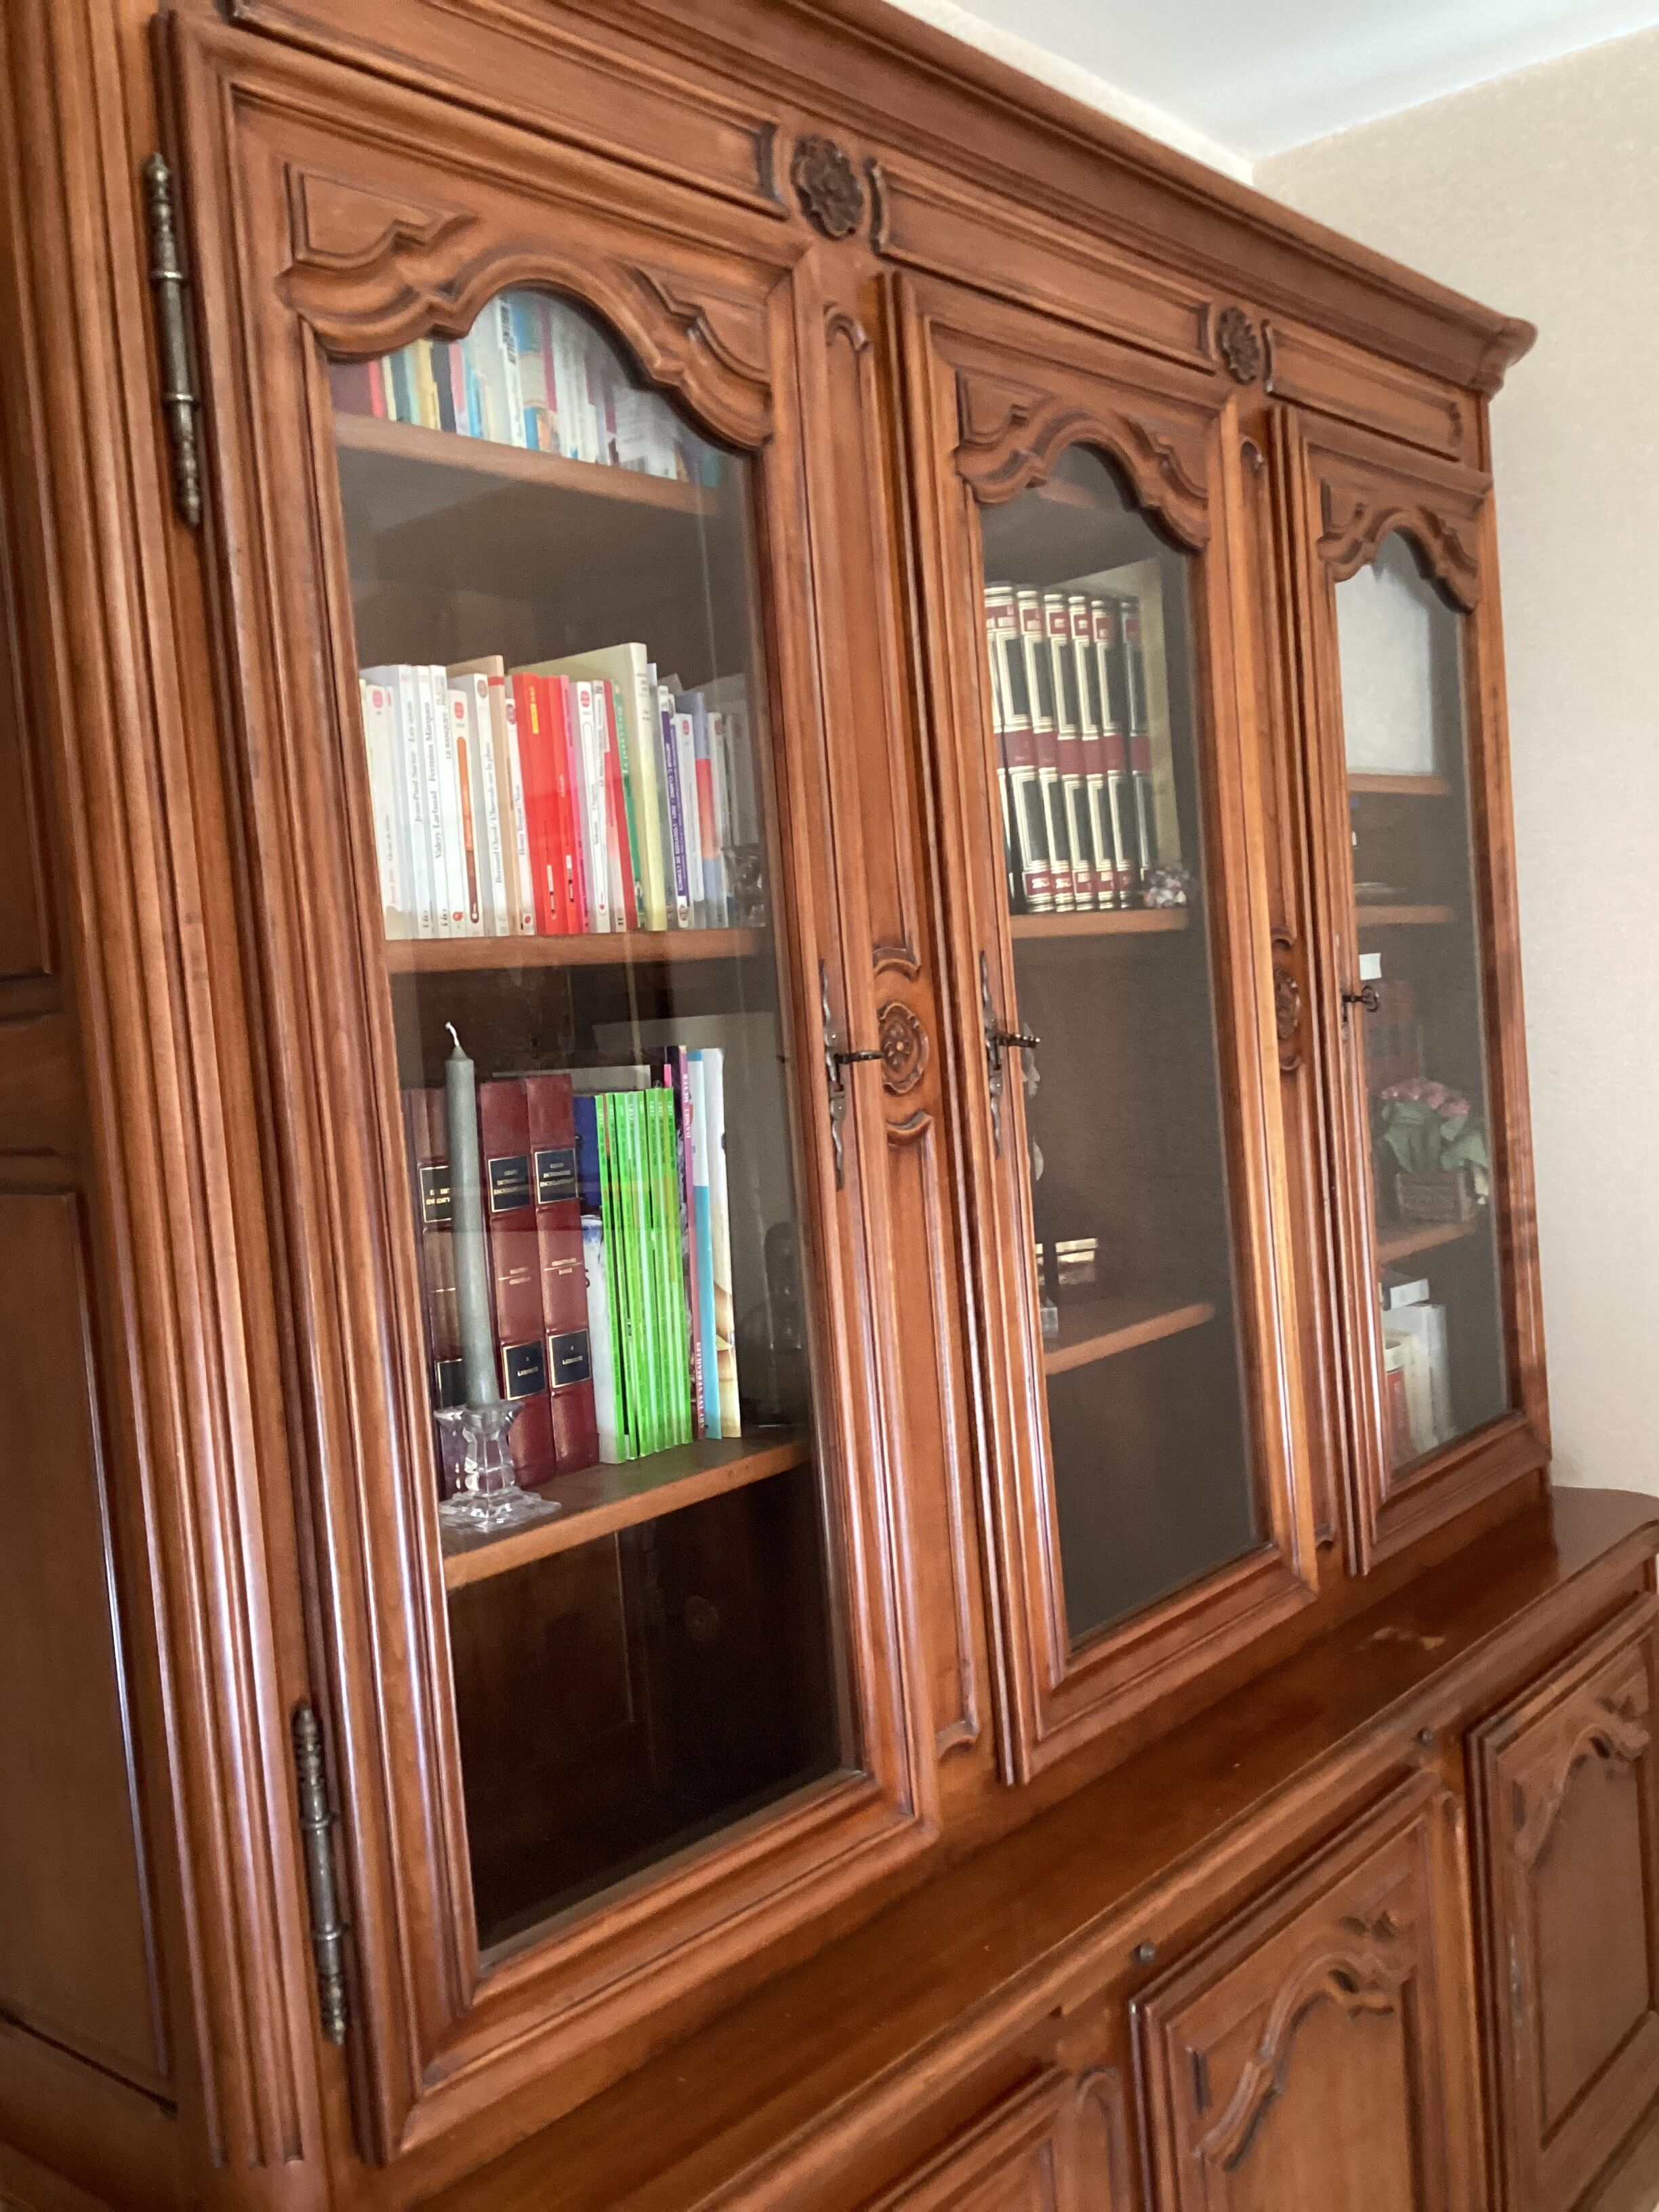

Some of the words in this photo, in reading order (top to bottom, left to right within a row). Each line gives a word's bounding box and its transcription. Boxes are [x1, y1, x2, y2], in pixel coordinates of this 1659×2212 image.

[443, 712, 451, 748] BANQUET
[428, 744, 436, 781] Fermina
[445, 750, 451, 759] LE
[430, 791, 439, 828] Larbaud
[695, 1341, 703, 1391] VERSAILLES
